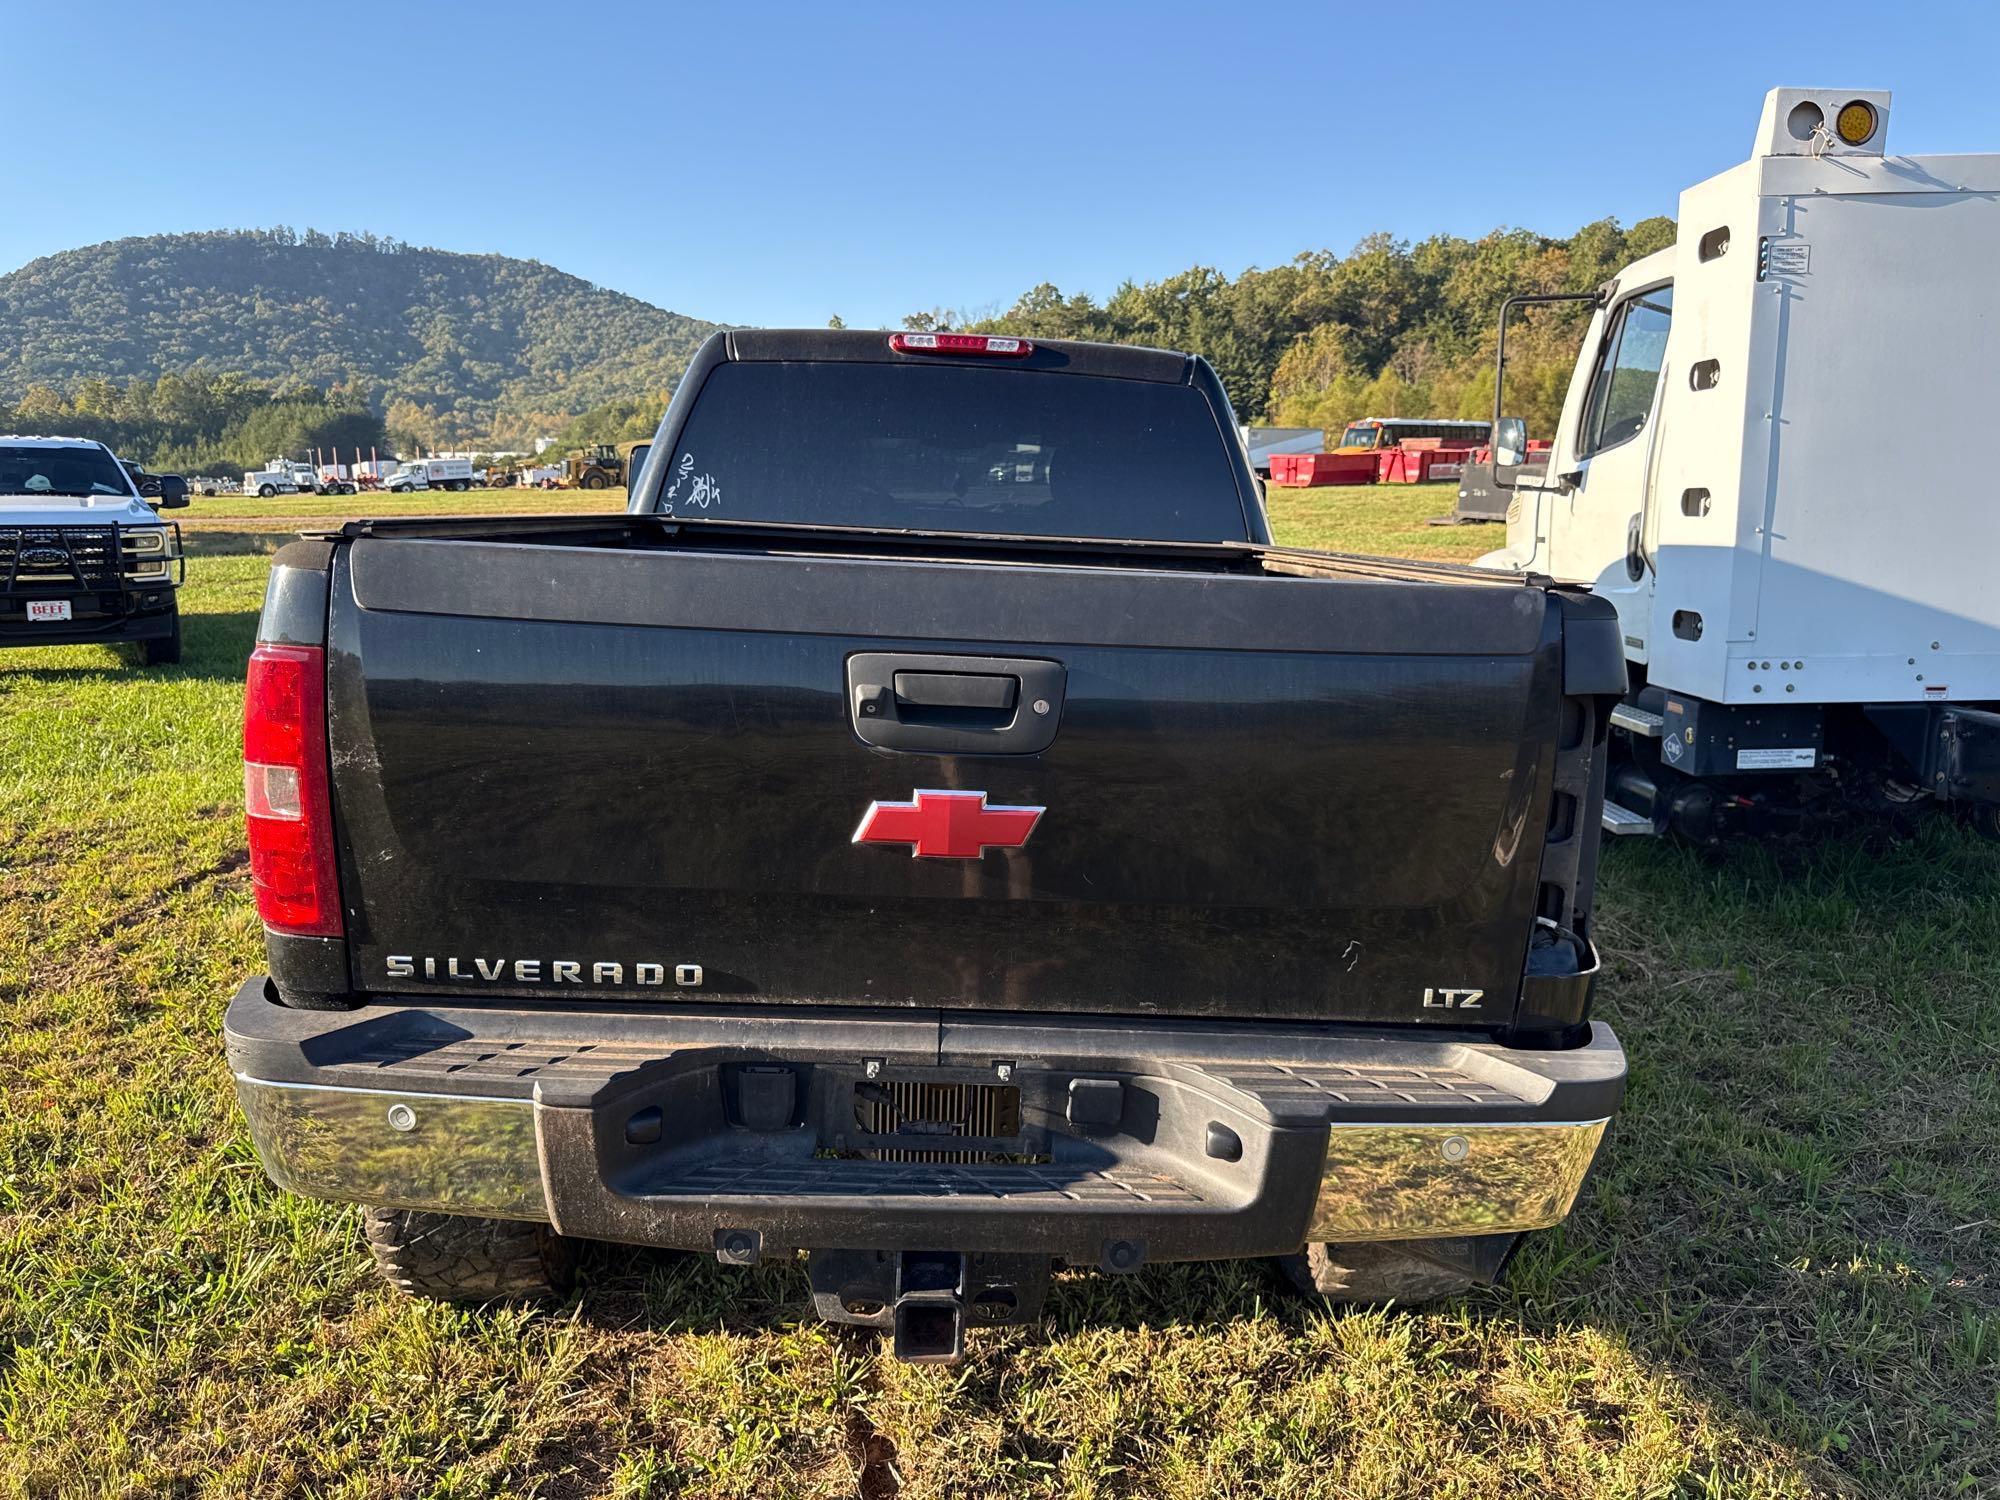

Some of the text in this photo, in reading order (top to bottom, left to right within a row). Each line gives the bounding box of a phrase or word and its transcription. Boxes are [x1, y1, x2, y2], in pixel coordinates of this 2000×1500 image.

[1667, 741, 1680, 755] CNG
[386, 955, 704, 987] SILVERADO
[1423, 988, 1484, 1009] LTZ
